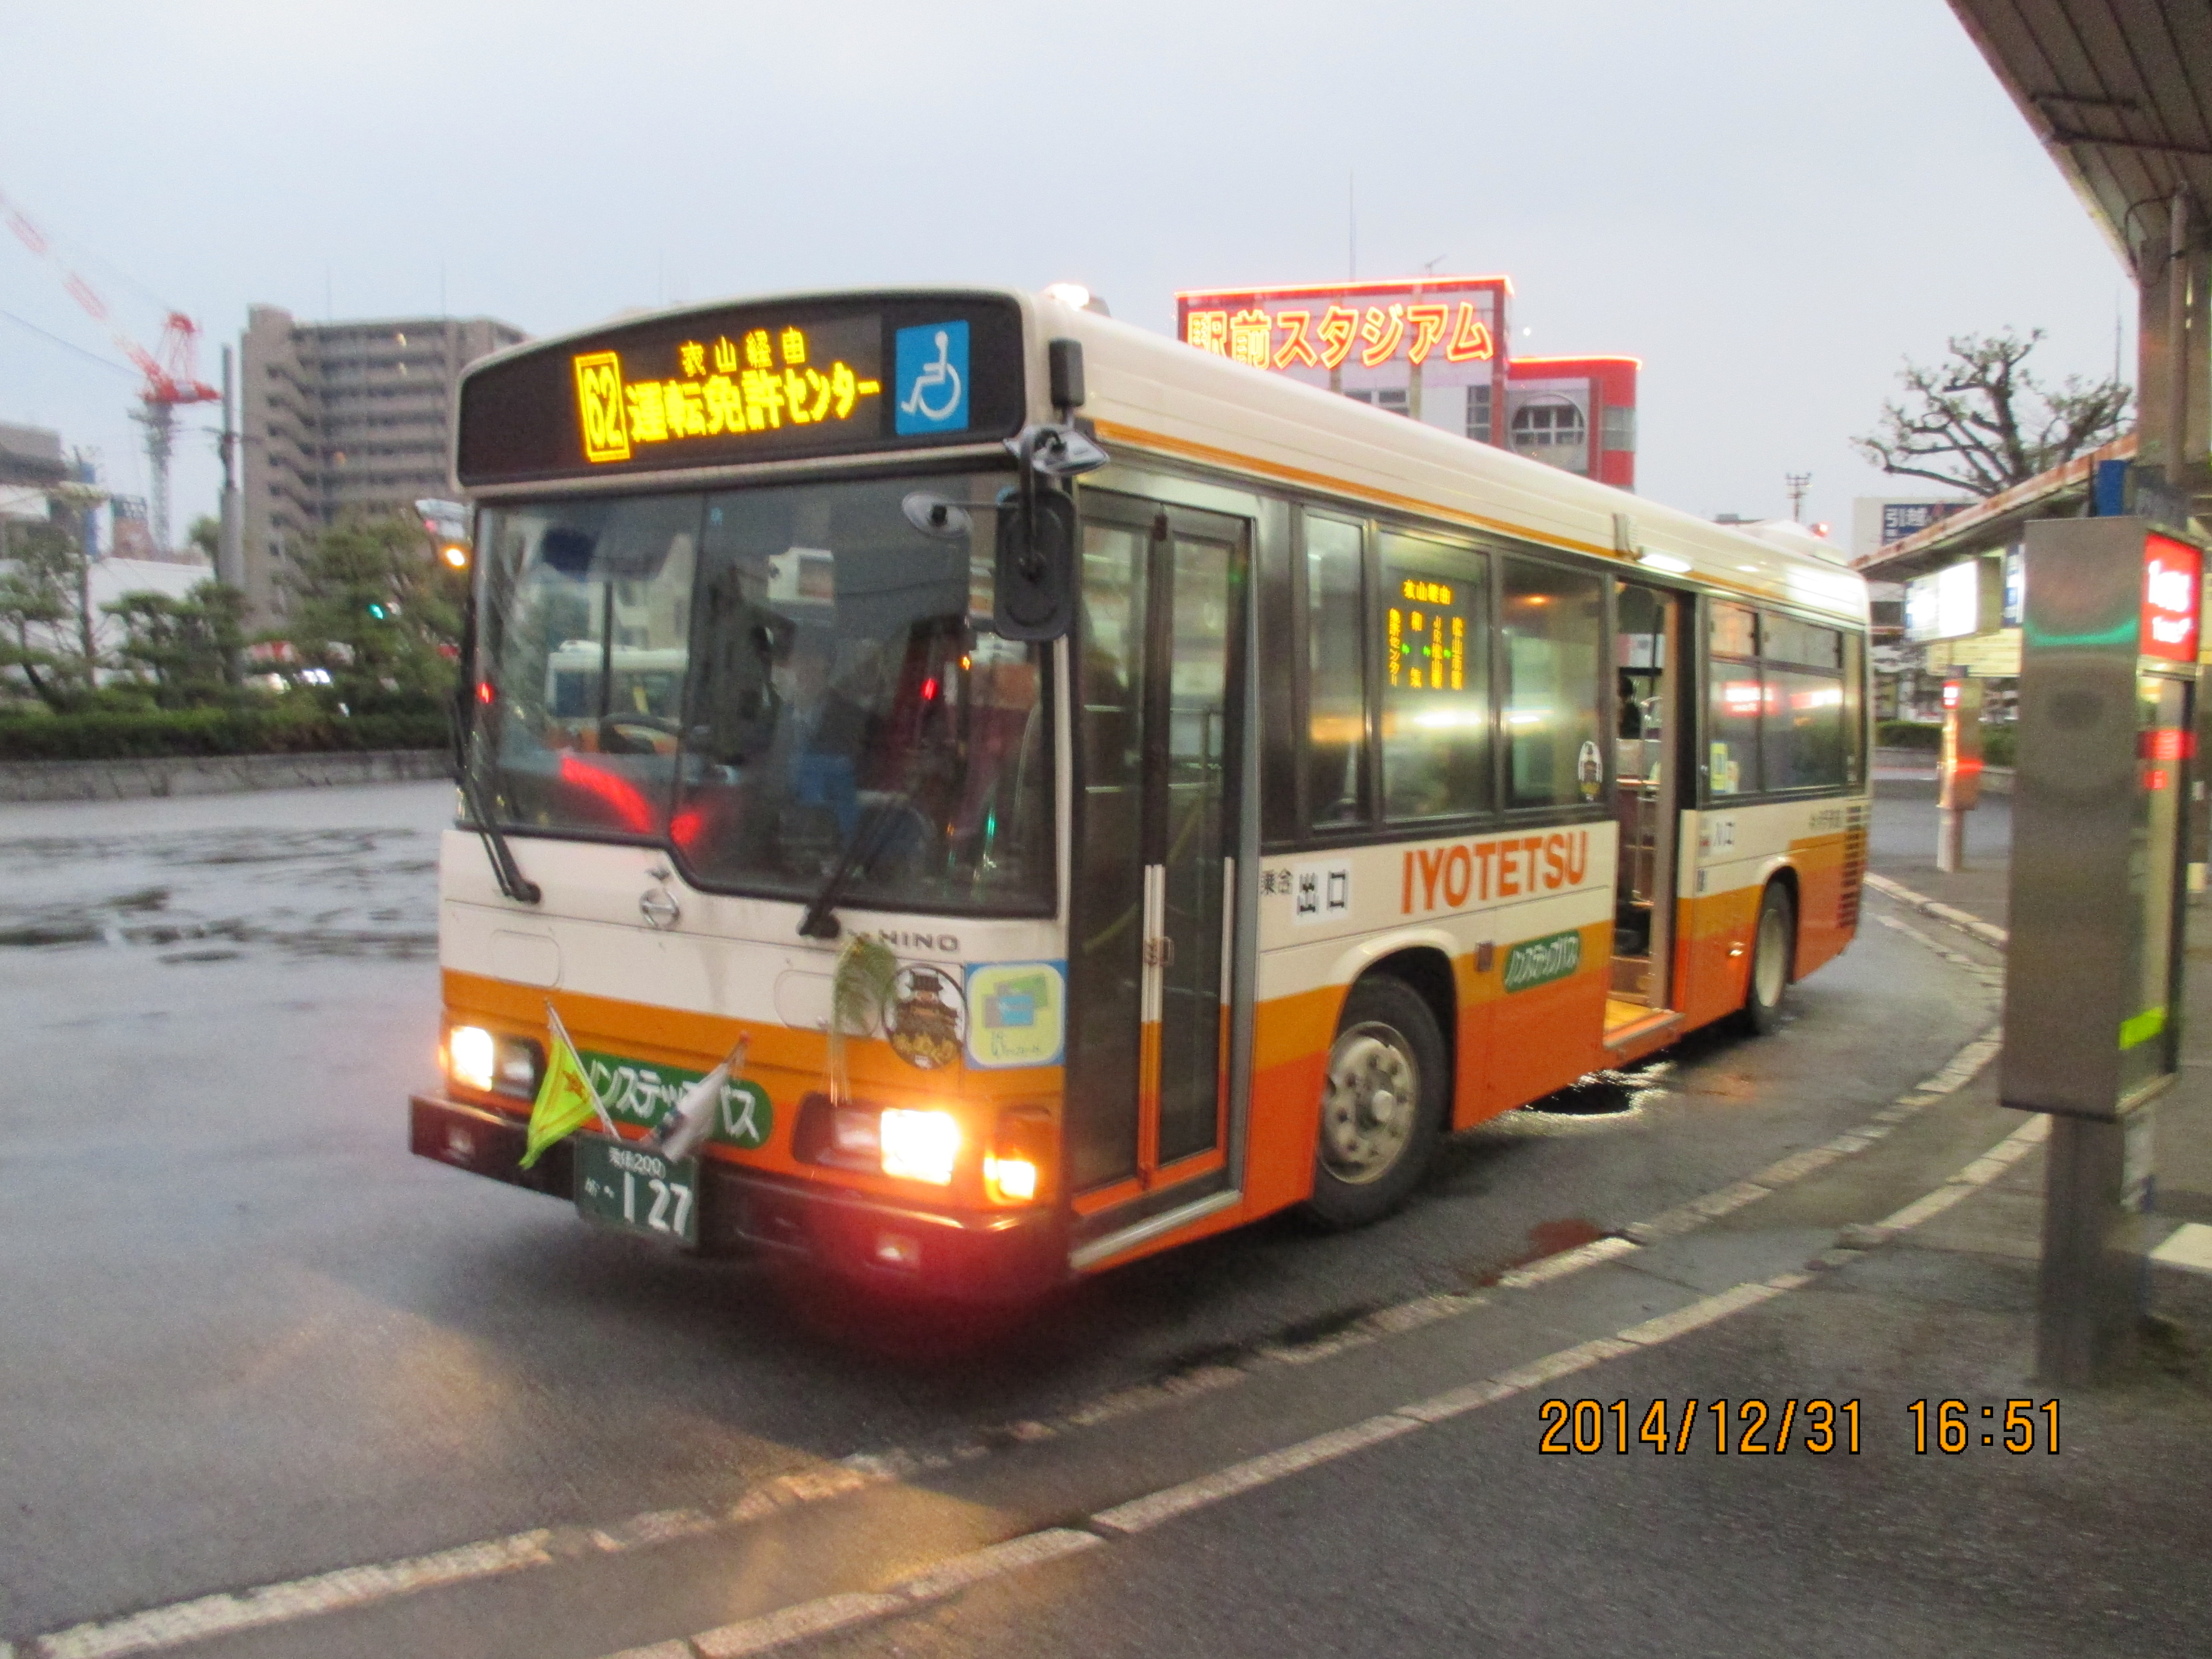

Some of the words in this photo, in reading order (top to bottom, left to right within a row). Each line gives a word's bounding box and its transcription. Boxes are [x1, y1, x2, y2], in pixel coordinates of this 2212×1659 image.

[1188, 301, 1494, 371] 駅前スタジアム
[583, 366, 624, 448] 62
[625, 362, 879, 442] 運転免許センター
[1261, 868, 1292, 896] 乗合
[1297, 870, 1347, 916] 出口
[1400, 831, 1589, 914] IYOTETSU
[878, 929, 960, 951] HINO
[624, 1171, 693, 1237] 127
